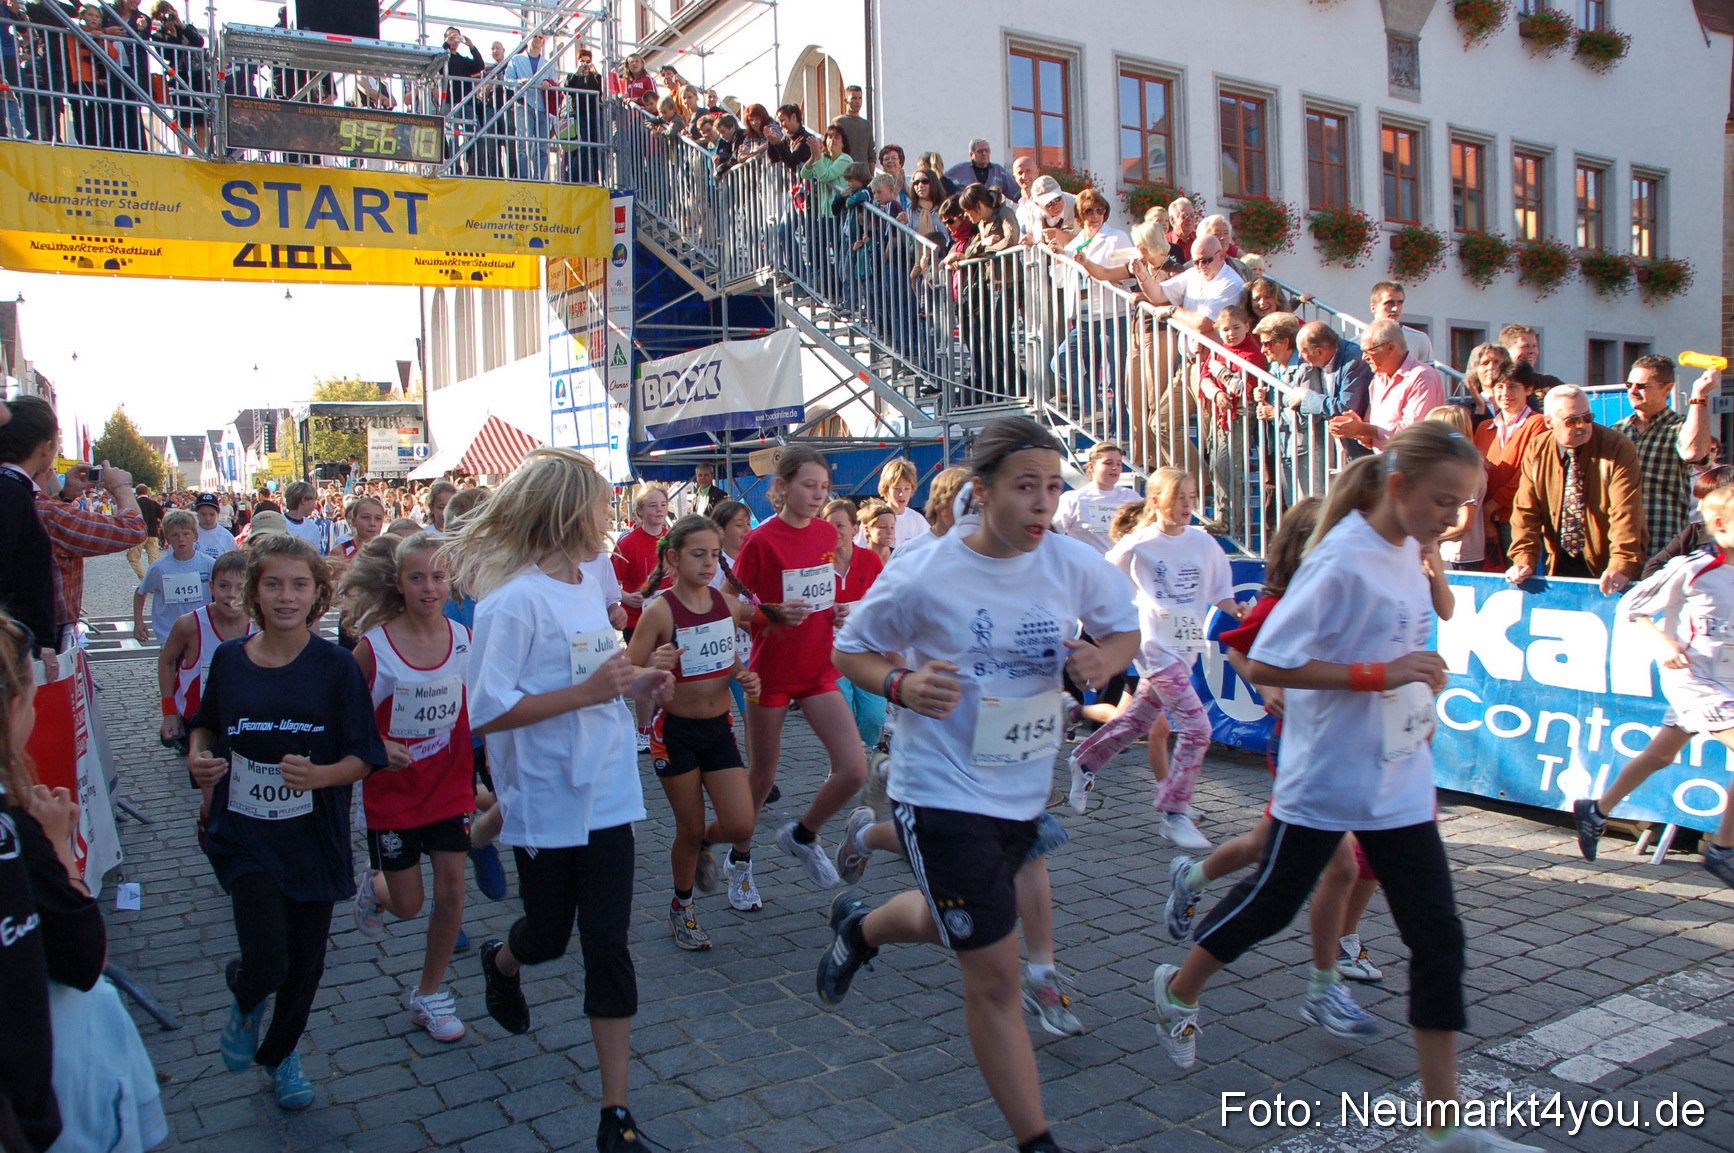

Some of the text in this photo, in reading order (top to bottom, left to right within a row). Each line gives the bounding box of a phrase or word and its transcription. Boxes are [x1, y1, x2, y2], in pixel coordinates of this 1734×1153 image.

[298, 107, 346, 118] Elektronische
[349, 111, 435, 126] Sportstätteneinrichtungen
[28, 191, 182, 213] Neumarkter Stadtlauf
[221, 180, 429, 235] START
[465, 219, 581, 235] Neumarkter Stadtlauf
[30, 240, 163, 256] Neumarkter Stadtlauf
[414, 257, 515, 269] Neumarkter Stadtlauf
[174, 585, 199, 595] 4151
[802, 581, 832, 598] 4084
[1174, 628, 1204, 640] 4152
[595, 636, 614, 653] Julia
[700, 636, 733, 657] 4068
[575, 663, 587, 675] Ju
[974, 662, 993, 677] 8.
[415, 686, 448, 698] Melanie
[395, 704, 405, 712] Ju
[414, 701, 456, 722] 4034
[1004, 714, 1056, 744] 4154
[248, 760, 283, 775] Mares
[233, 772, 240, 782] Ju
